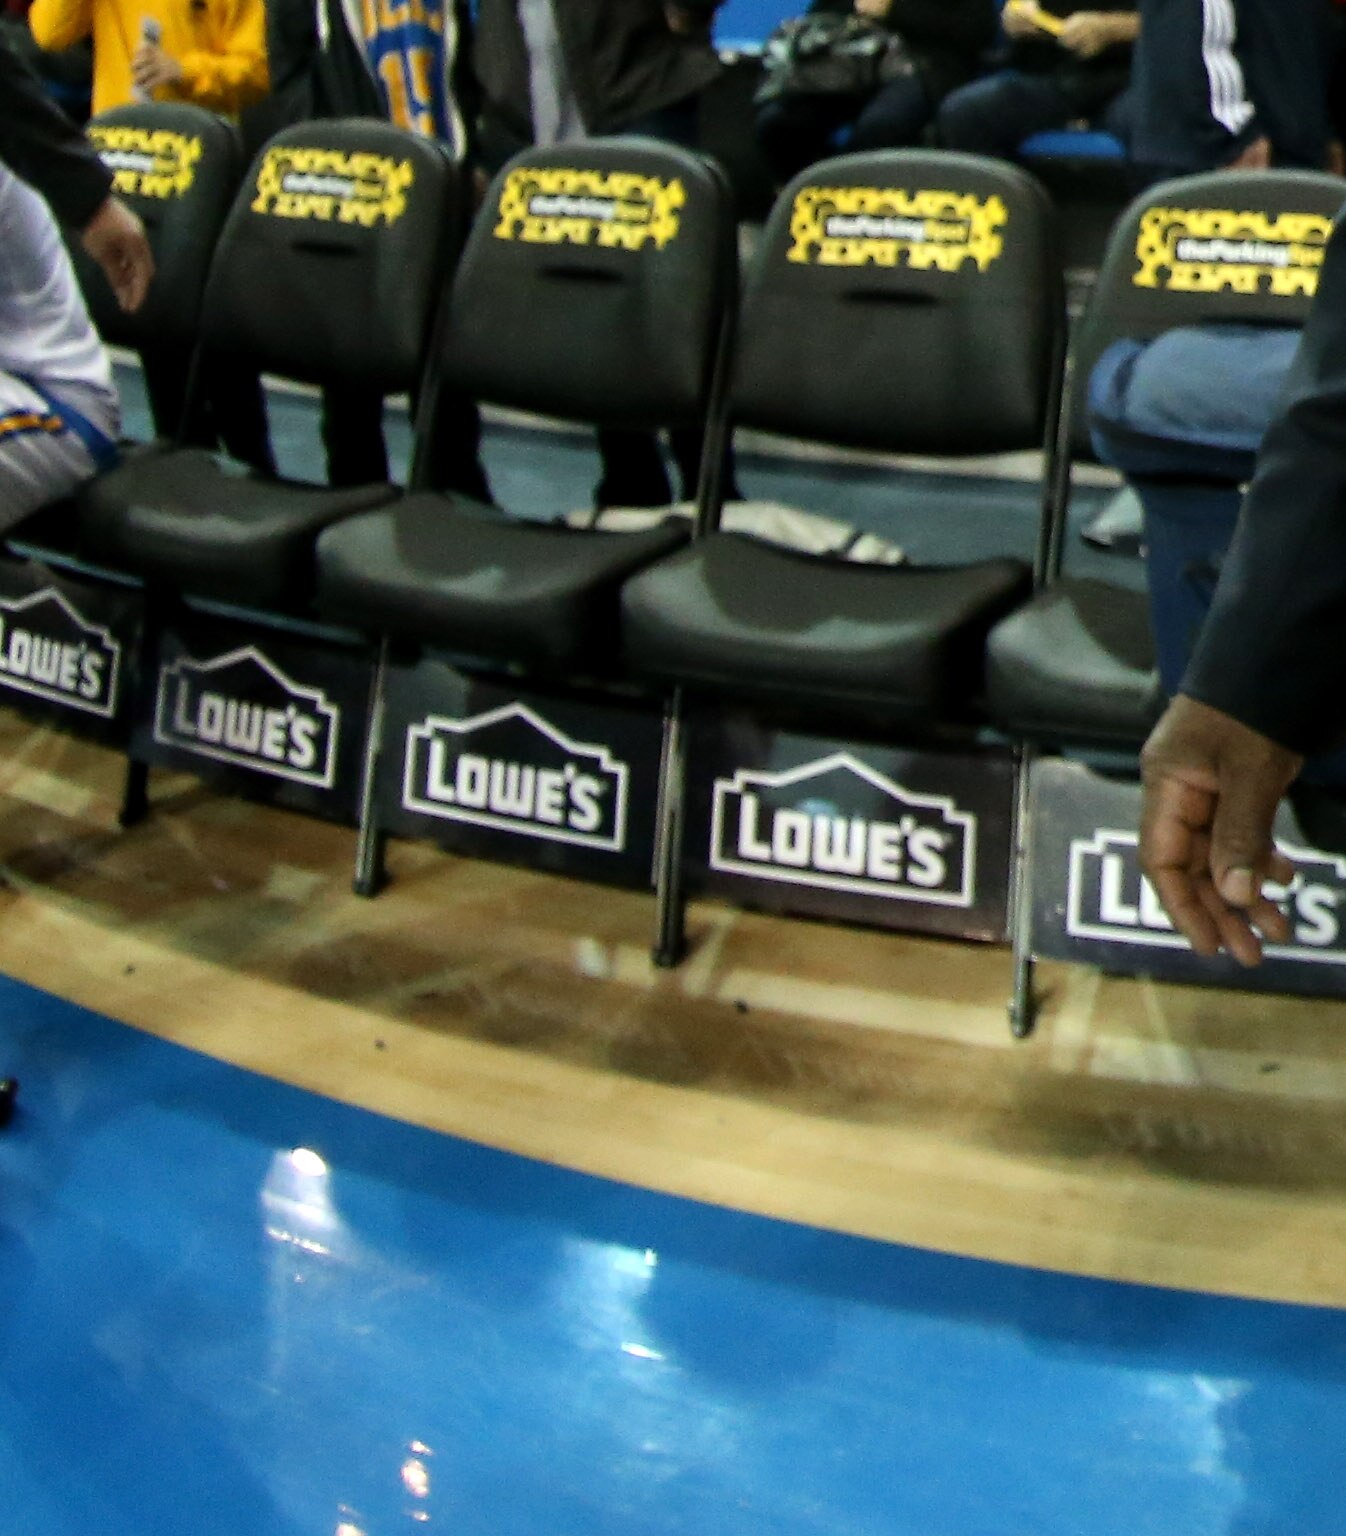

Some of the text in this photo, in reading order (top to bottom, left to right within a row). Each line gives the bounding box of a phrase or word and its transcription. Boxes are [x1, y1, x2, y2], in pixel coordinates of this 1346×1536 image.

[173, 675, 321, 770] LOWE'S
[426, 736, 602, 833] LOWE'S
[737, 792, 947, 888] LOWE'S
